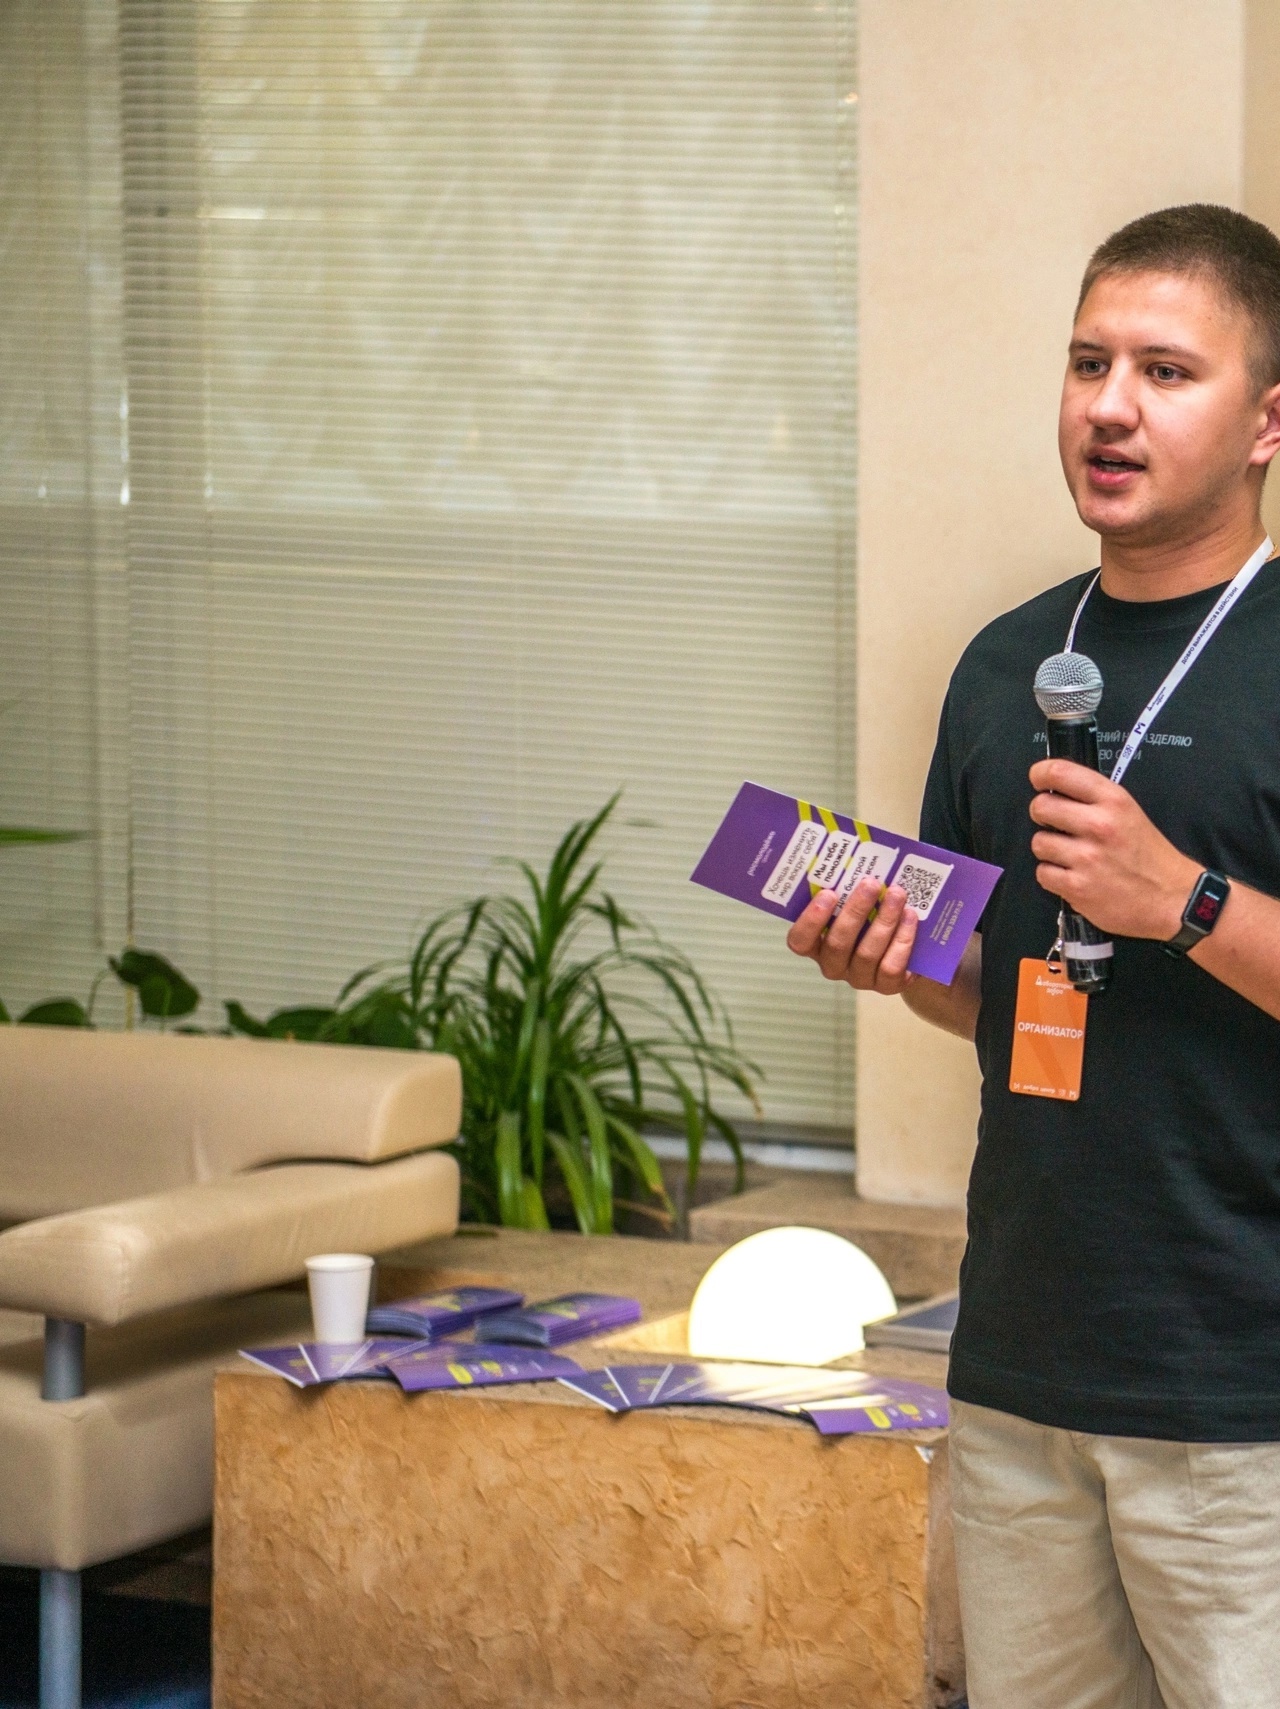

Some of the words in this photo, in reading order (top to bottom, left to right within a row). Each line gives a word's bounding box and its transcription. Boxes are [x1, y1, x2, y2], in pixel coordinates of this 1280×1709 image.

[1181, 645, 1195, 665] ДОБРО
[1193, 614, 1217, 647] ВЫРАЖАЕТСЯ
[1141, 733, 1193, 747] АЗДЕЛЯЮ
[767, 865, 790, 895] Хочешь
[788, 827, 811, 866] изменить
[779, 881, 792, 899] мир
[788, 857, 806, 882] вокруг
[813, 863, 827, 879] Мы
[825, 842, 838, 862] тебе
[824, 838, 851, 882] поможем!
[845, 856, 867, 891] быстрой
[865, 855, 879, 875] всем
[1018, 1021, 1084, 1039] ОРГАНИЗАТОР
